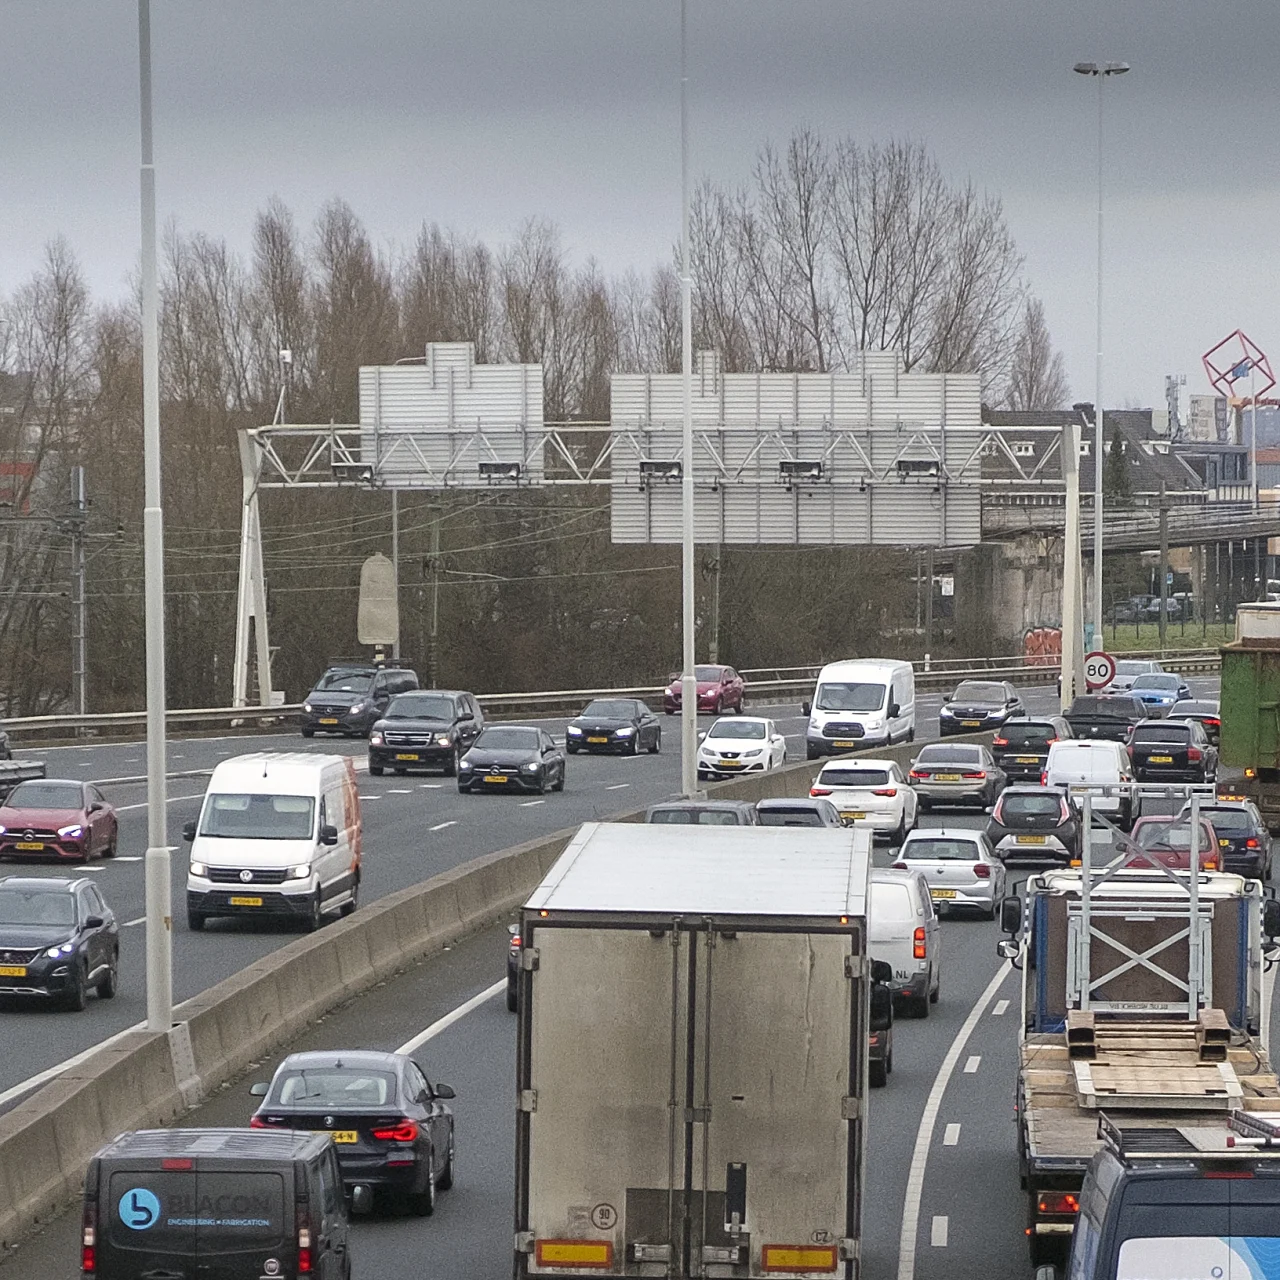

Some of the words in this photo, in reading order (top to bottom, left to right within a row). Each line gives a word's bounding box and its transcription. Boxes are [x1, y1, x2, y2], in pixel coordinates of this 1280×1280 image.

[1087, 664, 1109, 677] 80
[599, 1208, 610, 1220] 90
[221, 1218, 271, 1227] FABRICATION
